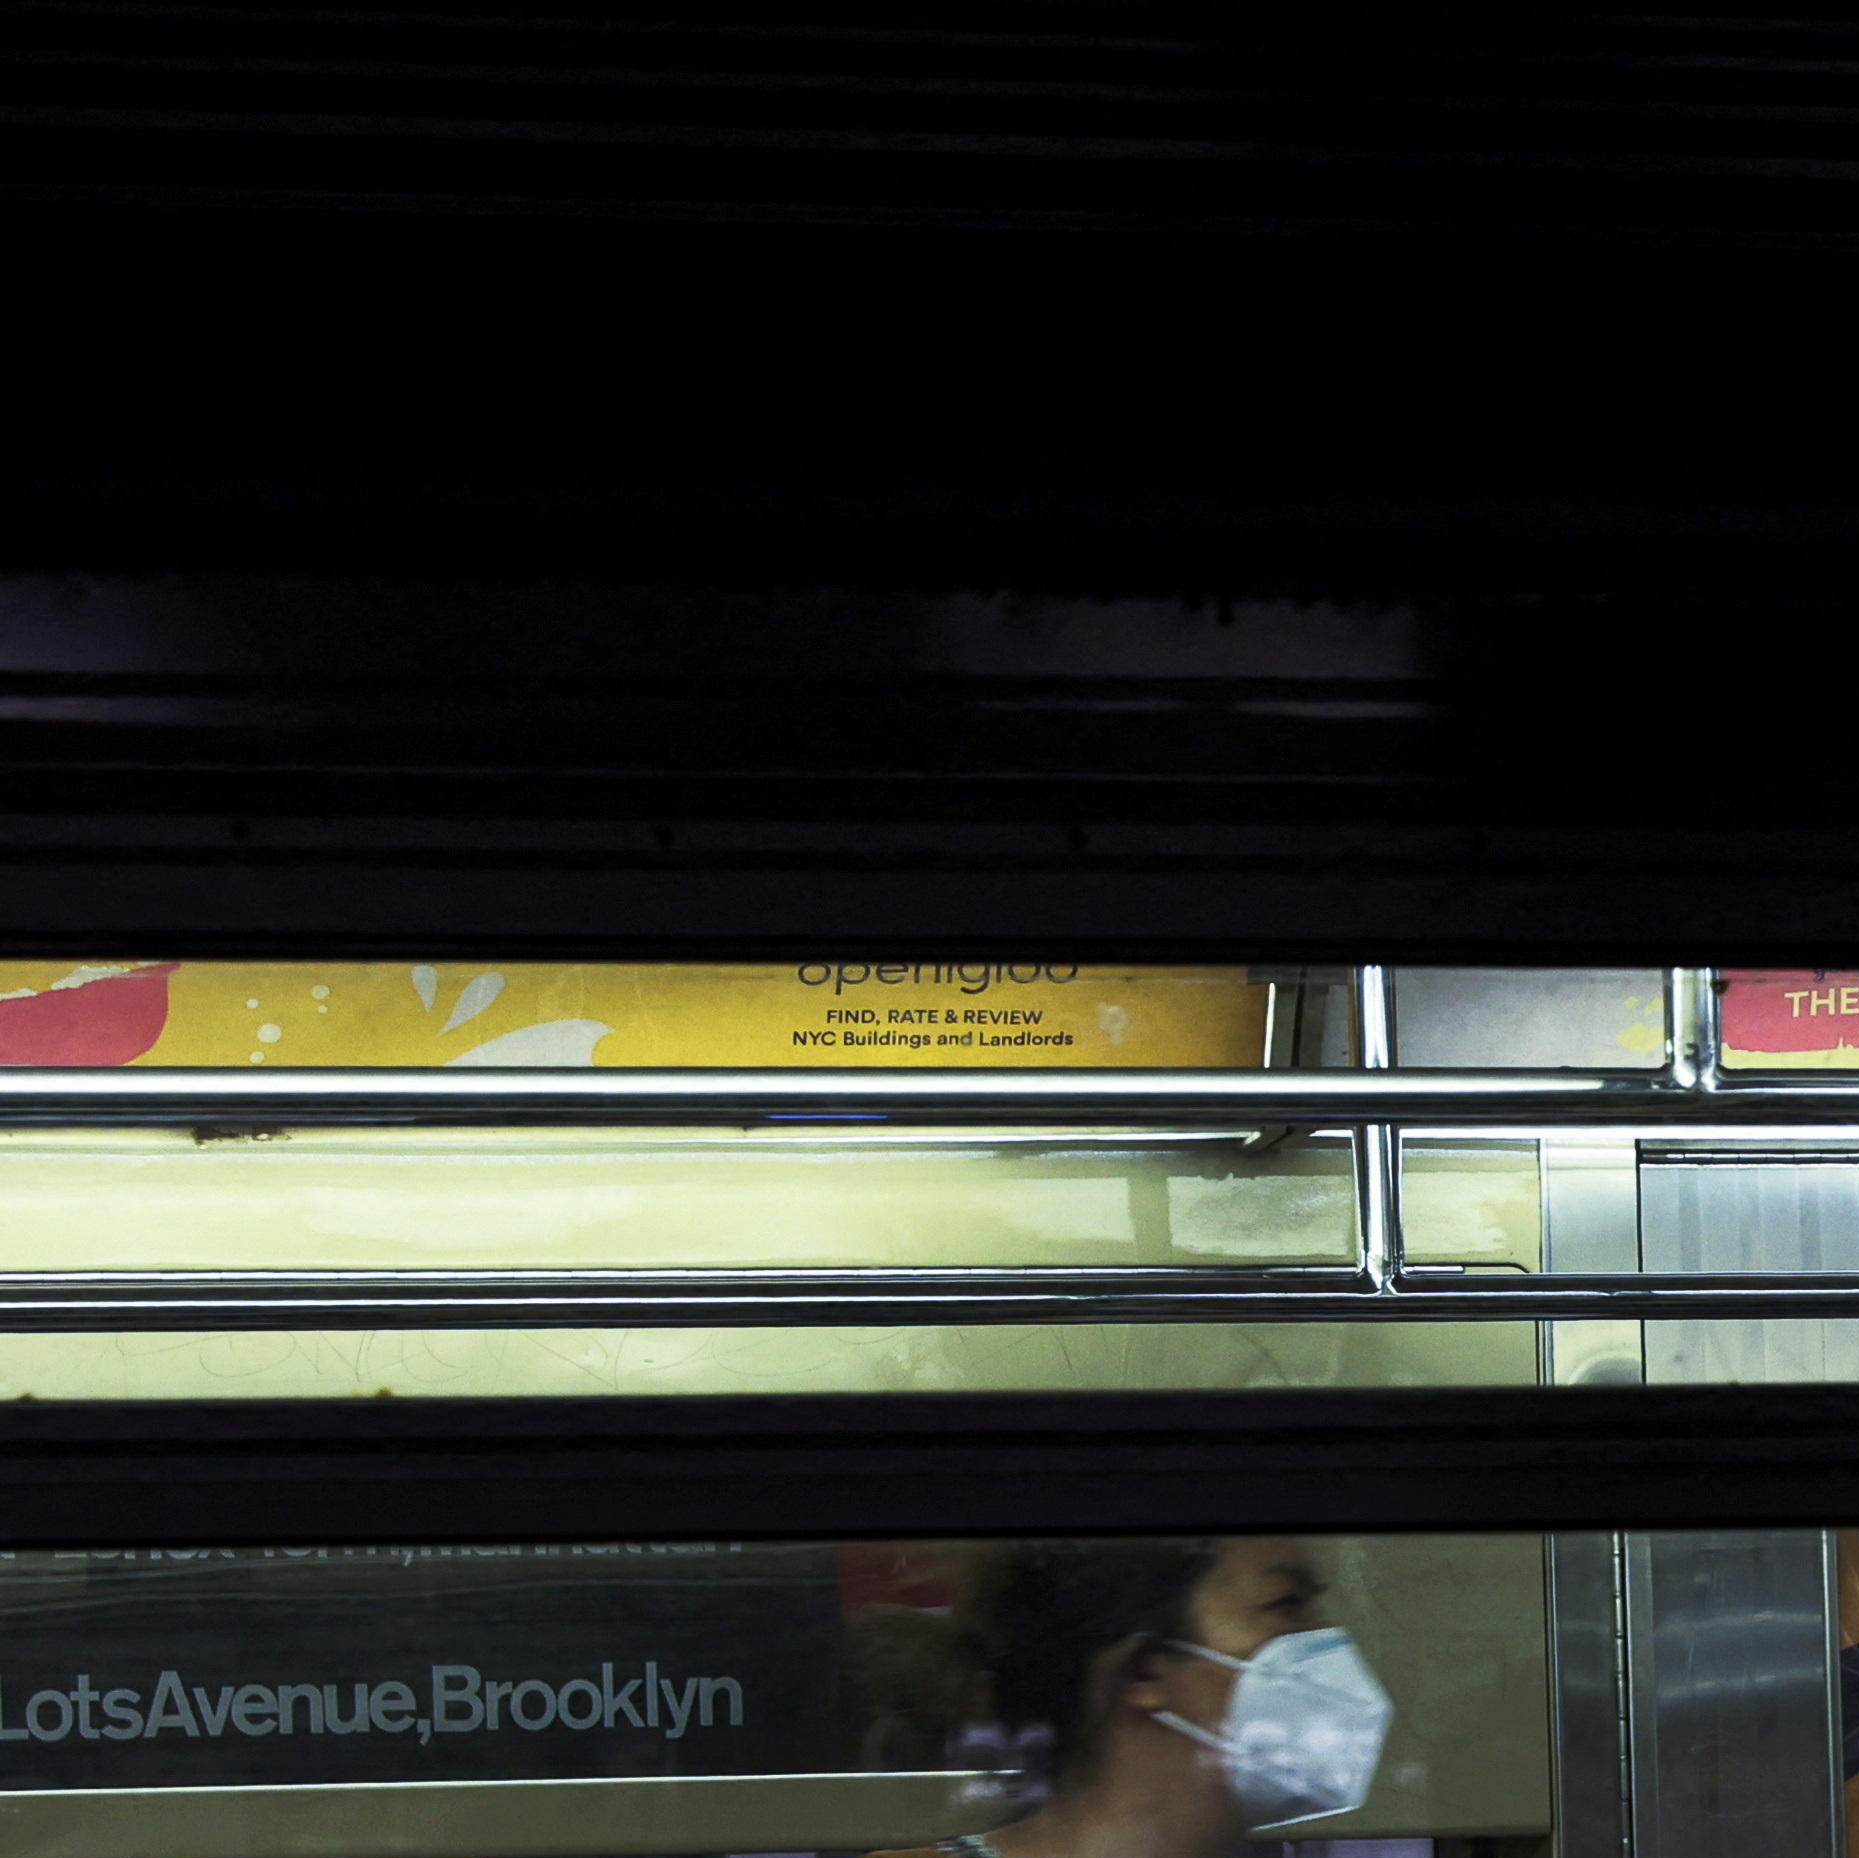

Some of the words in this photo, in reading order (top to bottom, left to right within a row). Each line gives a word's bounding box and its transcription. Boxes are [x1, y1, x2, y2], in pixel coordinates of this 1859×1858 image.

[1784, 986, 1859, 1018] THE
[826, 1009, 881, 1026] FIND,
[887, 1009, 939, 1024] RATE
[944, 1009, 959, 1024] &
[963, 1010, 1043, 1025] REVIEW
[792, 1031, 836, 1046] NYC
[843, 1031, 931, 1050] Buildings
[936, 1031, 973, 1046] and
[978, 1031, 1074, 1047] Landlords
